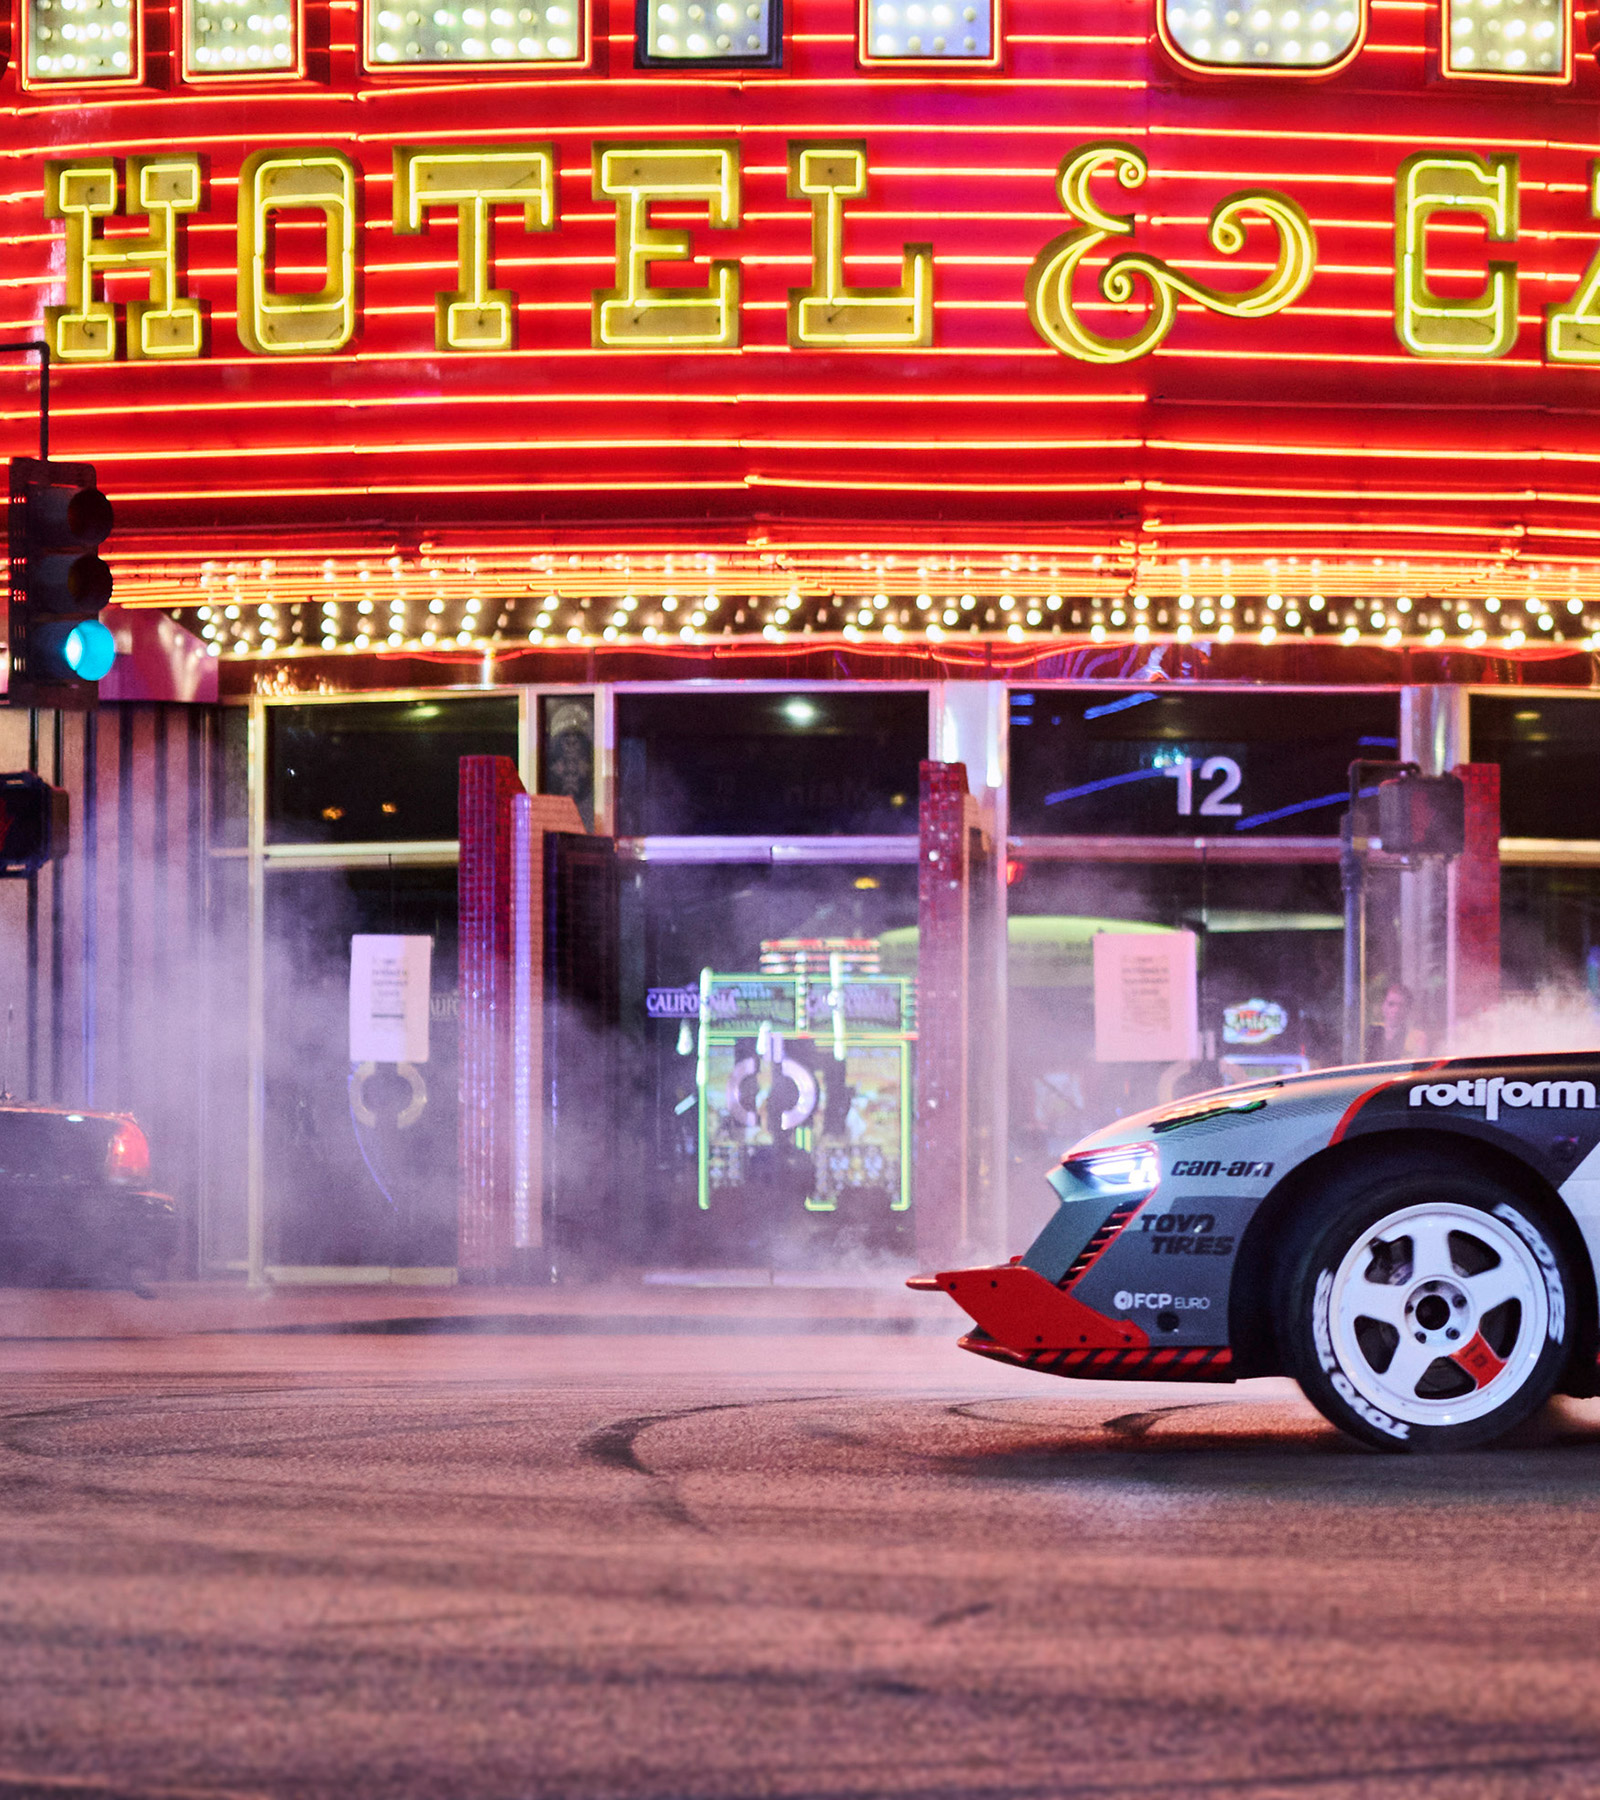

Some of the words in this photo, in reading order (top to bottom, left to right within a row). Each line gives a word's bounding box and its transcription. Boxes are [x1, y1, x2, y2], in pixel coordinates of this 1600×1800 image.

[45, 140, 934, 362] HOTEL
[1024, 140, 1317, 364] &
[1164, 756, 1242, 816] 12
[646, 991, 738, 1013] CALIFONIA
[1409, 1077, 1597, 1121] rotiform
[1171, 1160, 1276, 1177] can-am
[1141, 1213, 1215, 1233] TOYO
[1151, 1235, 1235, 1256] TIRES
[1134, 1292, 1173, 1310] FCP
[1174, 1296, 1211, 1310] EURO
